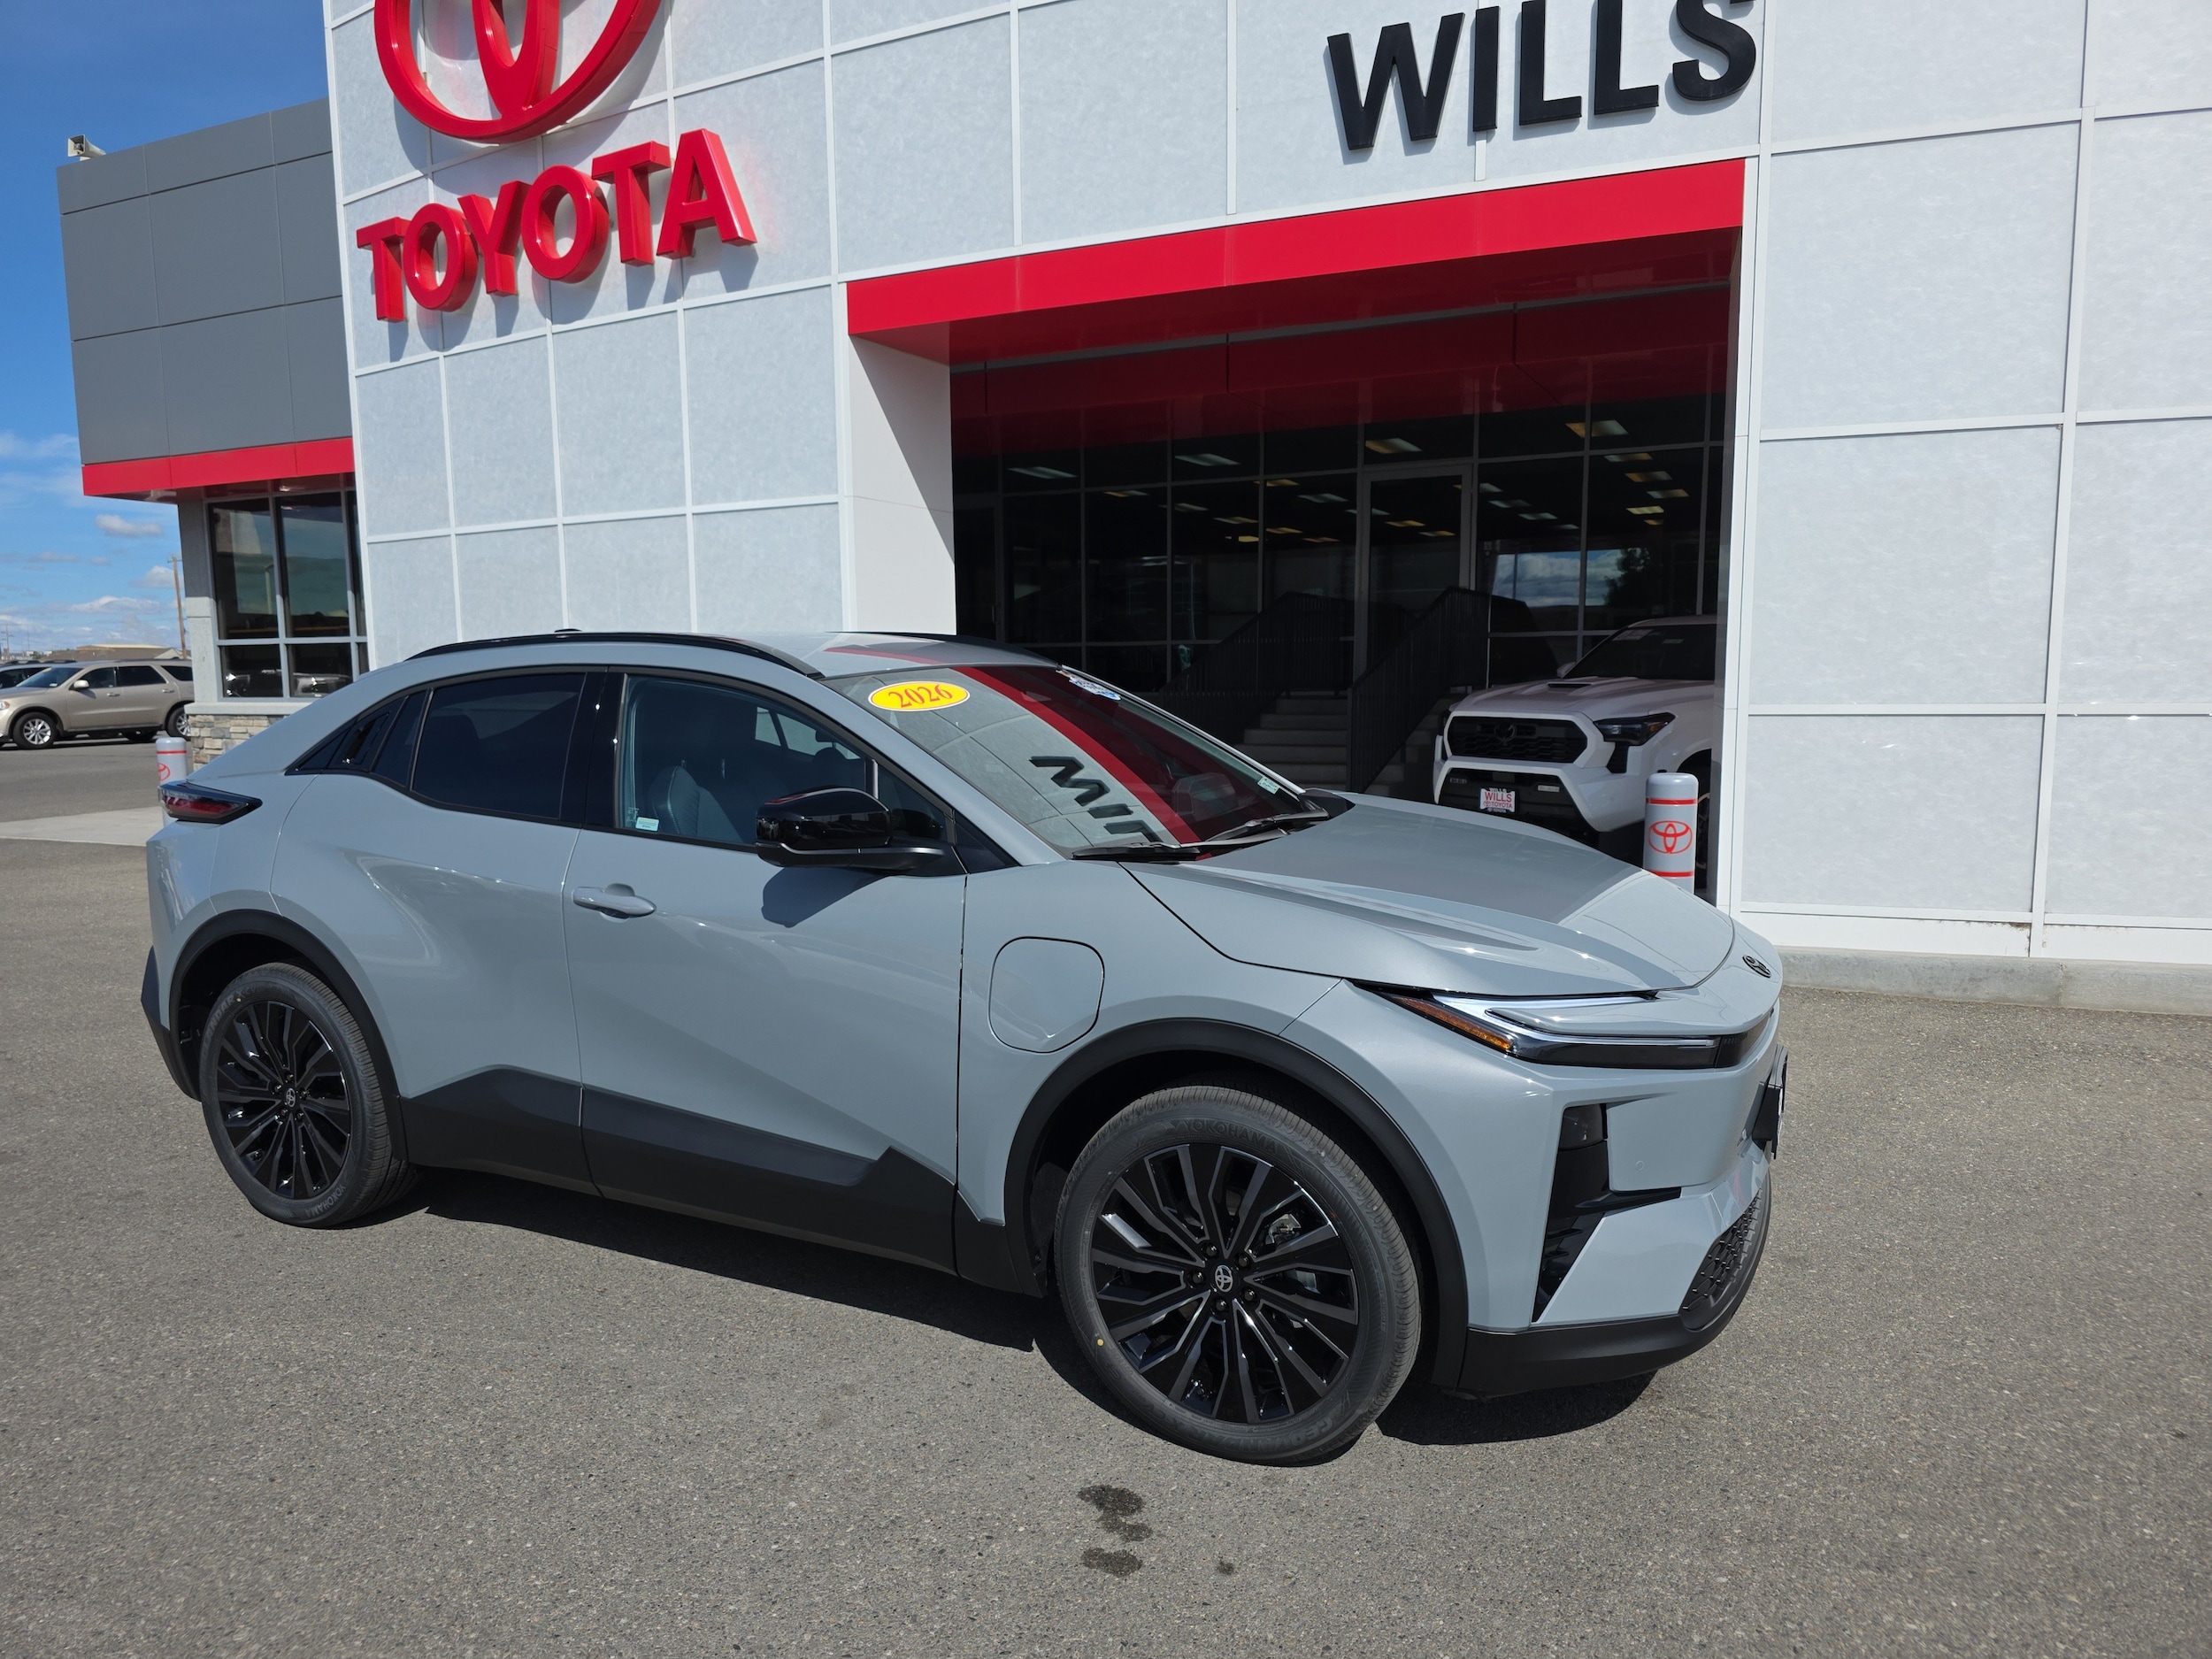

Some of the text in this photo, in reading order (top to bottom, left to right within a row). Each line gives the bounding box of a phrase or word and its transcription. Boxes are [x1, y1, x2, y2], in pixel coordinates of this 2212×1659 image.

[1327, 0, 1756, 151] WILLS
[357, 128, 757, 322] TOYOTA
[887, 684, 953, 708] 2026
[1485, 792, 1512, 803] WILLS
[1173, 1119, 1279, 1153] YOKOHAMA
[303, 1180, 347, 1217] YOKOHAMA
